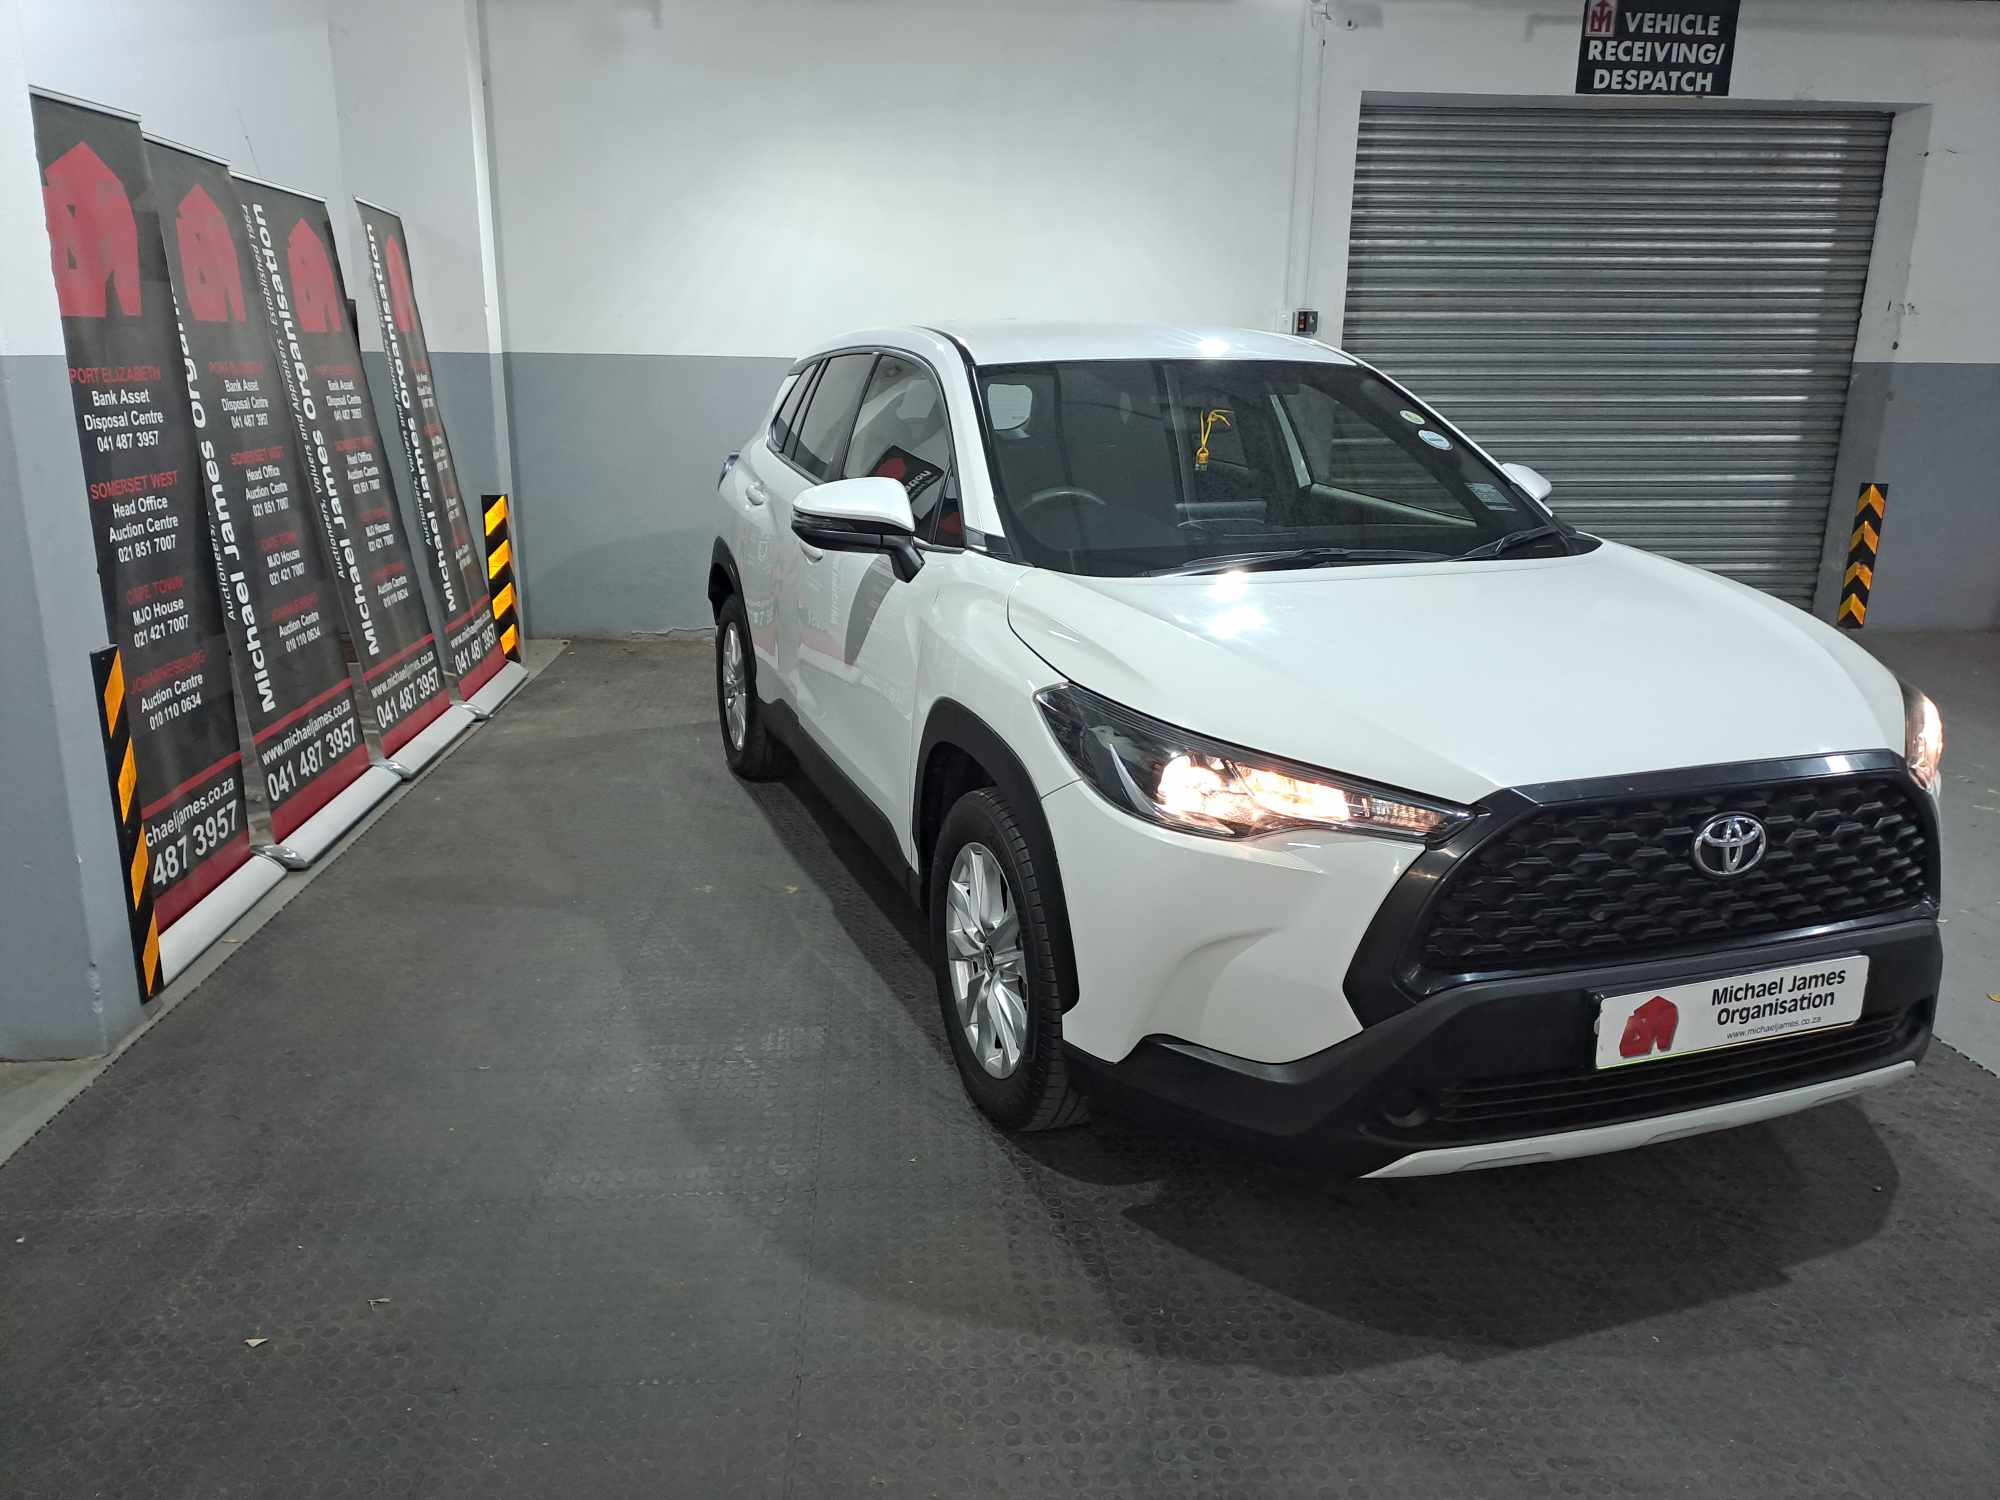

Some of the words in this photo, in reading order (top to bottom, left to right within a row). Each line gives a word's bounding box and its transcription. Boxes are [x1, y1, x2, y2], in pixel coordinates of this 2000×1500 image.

[1625, 12, 1721, 36] VEHICLE
[1588, 40, 1726, 65] RECEIVING/
[1593, 69, 1713, 92] DESPATCH
[253, 203, 316, 420] Organisation
[366, 223, 410, 409] Organisation
[68, 366, 98, 384] PORT
[91, 389, 118, 407] Bank
[120, 388, 151, 404] Asset
[221, 397, 251, 413] Disposal
[84, 411, 129, 432] Disposal
[130, 410, 164, 426] Centre
[231, 415, 243, 429] 041
[295, 413, 309, 440] and
[97, 435, 114, 452] 041
[116, 433, 133, 450] 487
[136, 430, 159, 447] 3957
[246, 466, 263, 482] Head
[304, 443, 322, 494] Valuers
[407, 417, 432, 504] James
[90, 475, 147, 500] SOMERSET
[150, 470, 178, 488] WEST
[245, 485, 270, 500] Auction
[312, 429, 346, 530] James
[112, 499, 137, 519] Head
[138, 495, 168, 513] Office
[201, 440, 240, 560] James
[252, 502, 264, 517] 021
[109, 522, 145, 543] Auction
[146, 514, 179, 533] Centre
[118, 545, 133, 563] 021
[135, 540, 151, 558] 851
[154, 534, 176, 553] 7007
[427, 511, 456, 612] Michael
[339, 538, 380, 656] Michael
[132, 606, 152, 626] MJO
[153, 598, 184, 618] House
[134, 630, 149, 648] 021
[150, 623, 166, 641] 421
[167, 614, 190, 634] 7007
[230, 571, 277, 713] Michael
[279, 619, 301, 638] Auction
[454, 647, 471, 675] 041
[141, 688, 173, 713] Auction
[174, 673, 204, 695] Centre
[376, 696, 399, 729] 041
[399, 682, 417, 713] 487
[416, 666, 440, 699] 3957
[149, 710, 163, 730] 010
[164, 702, 180, 721] 110
[181, 692, 202, 714] 0634
[267, 760, 297, 802] 041
[300, 740, 323, 777] 487
[325, 717, 357, 759] 3957
[145, 777, 235, 847] chaeljames.co.za
[152, 834, 187, 885] 487
[192, 799, 237, 856] 3957
[1711, 977, 1784, 1006] Michael
[1787, 969, 1846, 993] James
[1717, 991, 1835, 1026] Organisation
